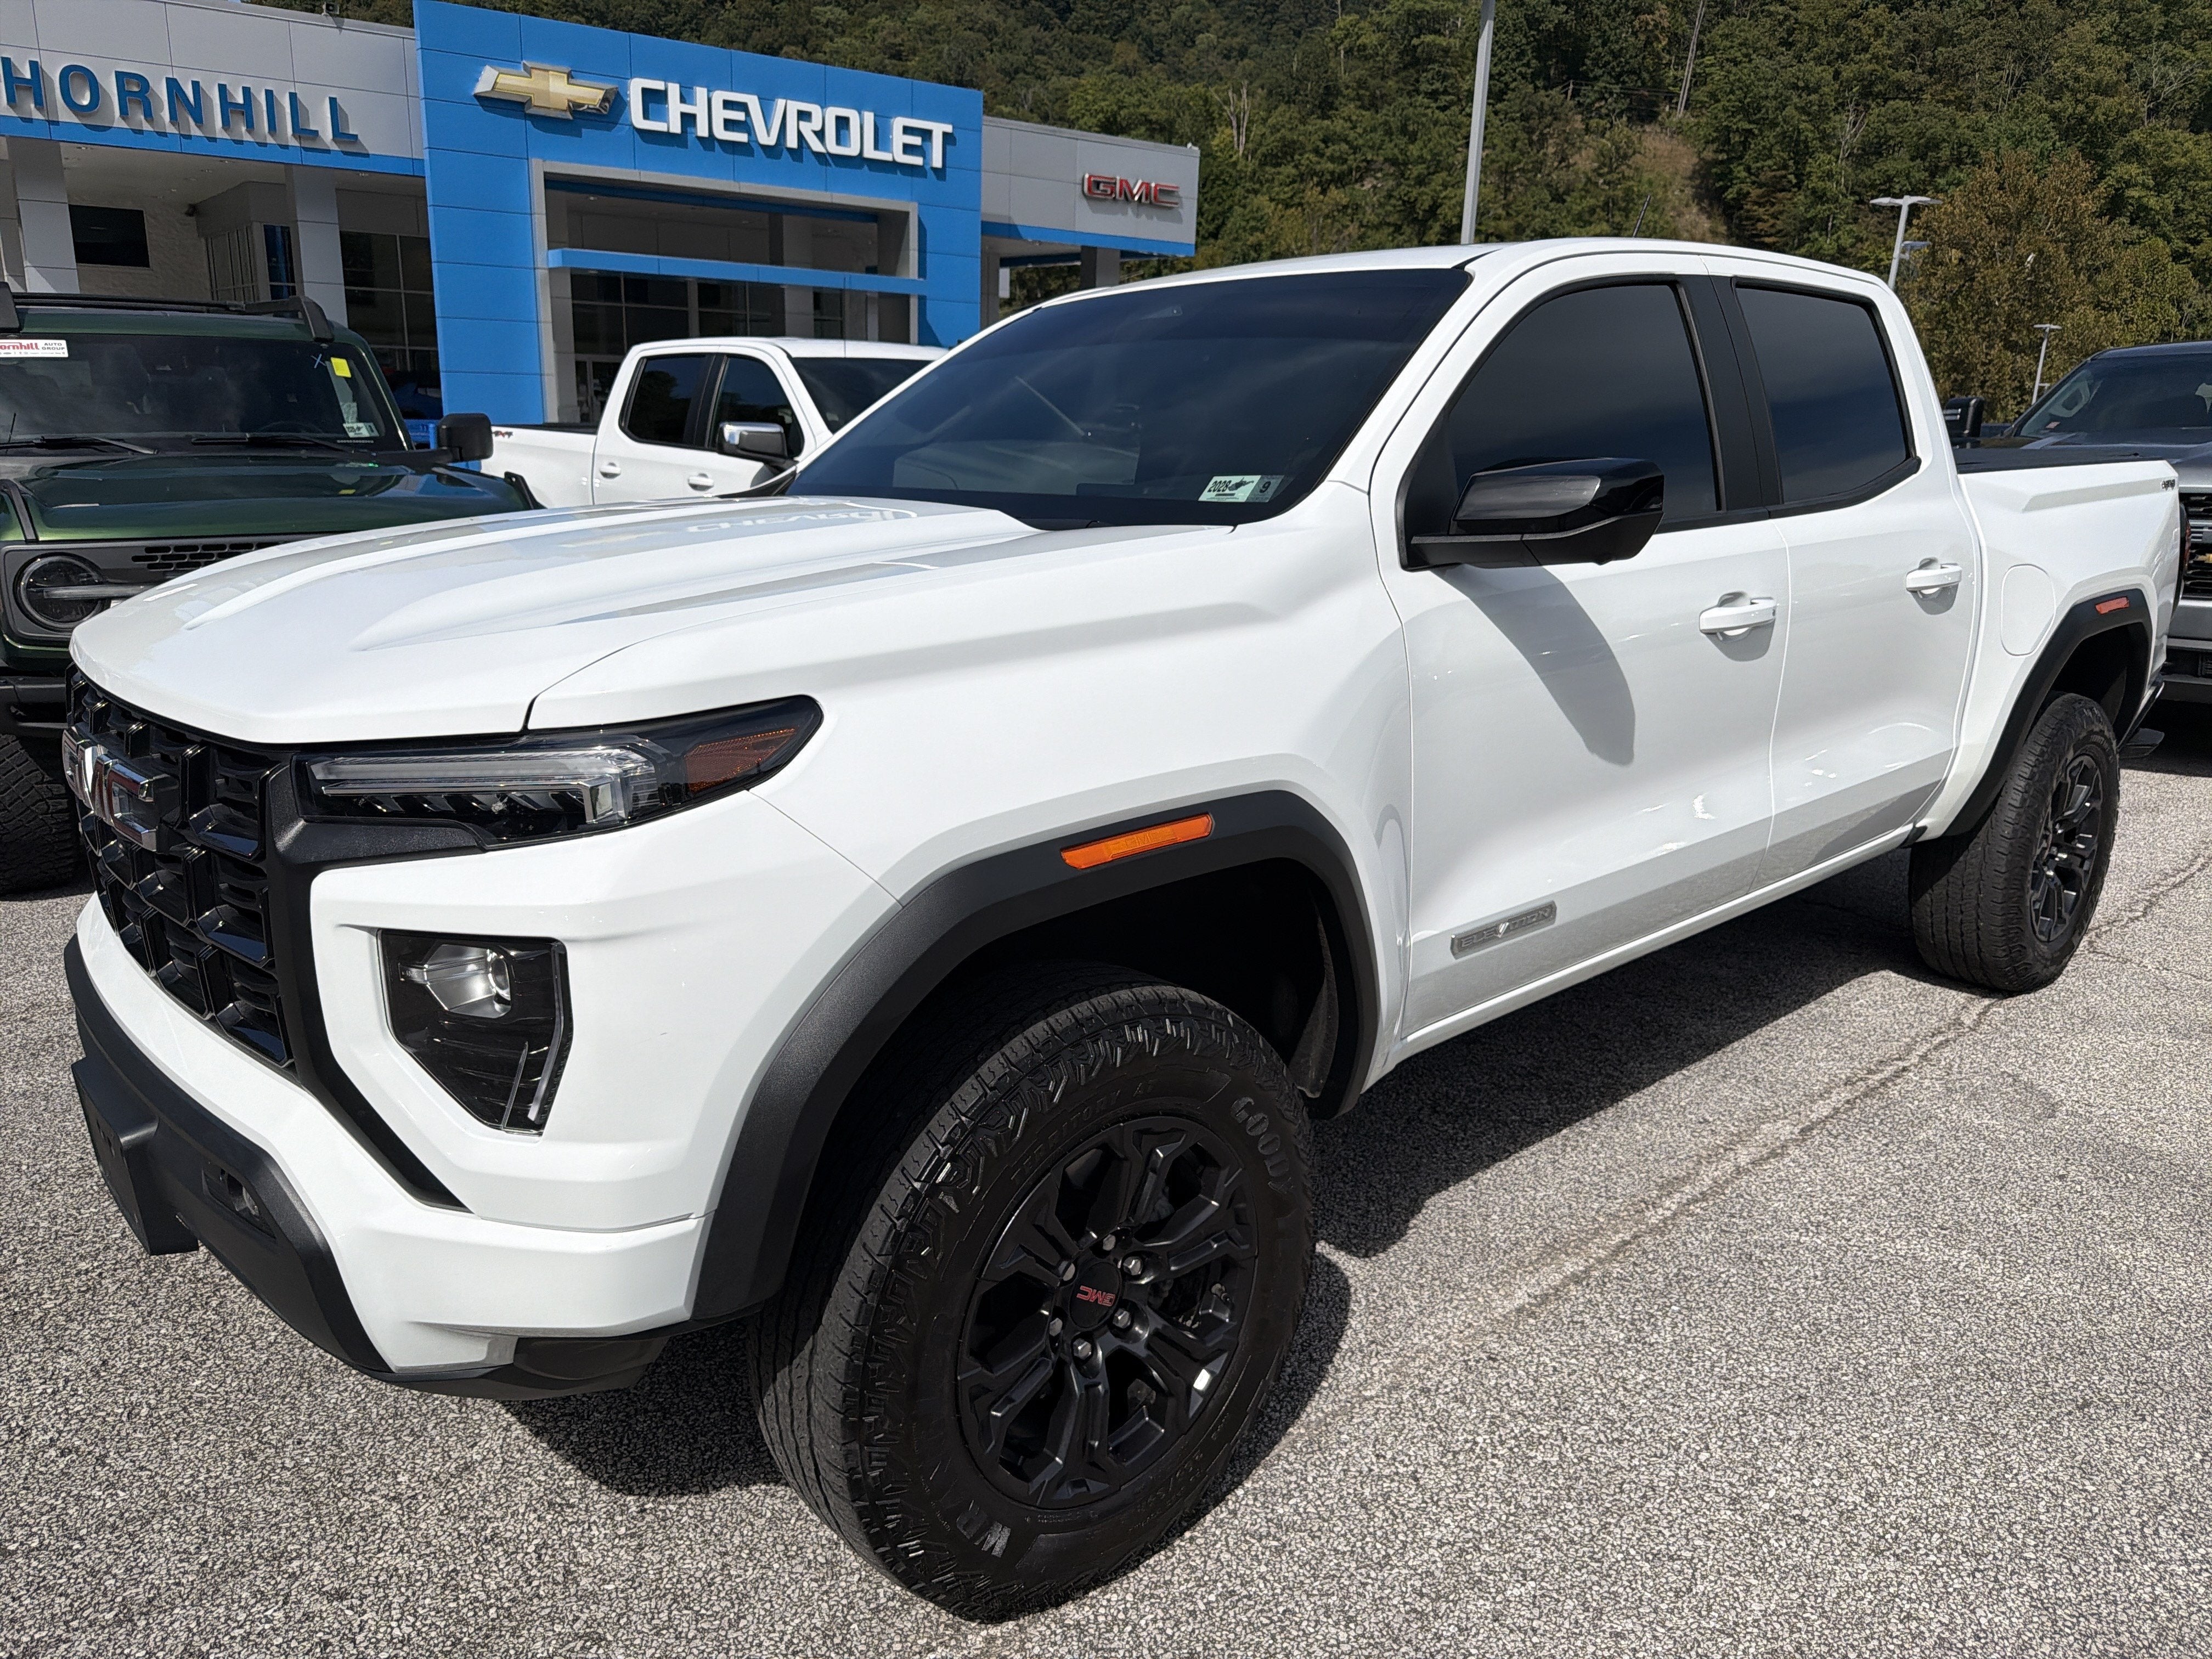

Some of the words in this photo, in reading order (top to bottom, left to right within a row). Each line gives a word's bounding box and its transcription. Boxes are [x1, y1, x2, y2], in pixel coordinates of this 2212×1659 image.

[628, 77, 953, 169] CHEVROLET
[1083, 172, 1180, 207] GMC
[1259, 481, 1271, 493] 9
[62, 729, 157, 852] GMC
[1076, 1285, 1116, 1307] GMC
